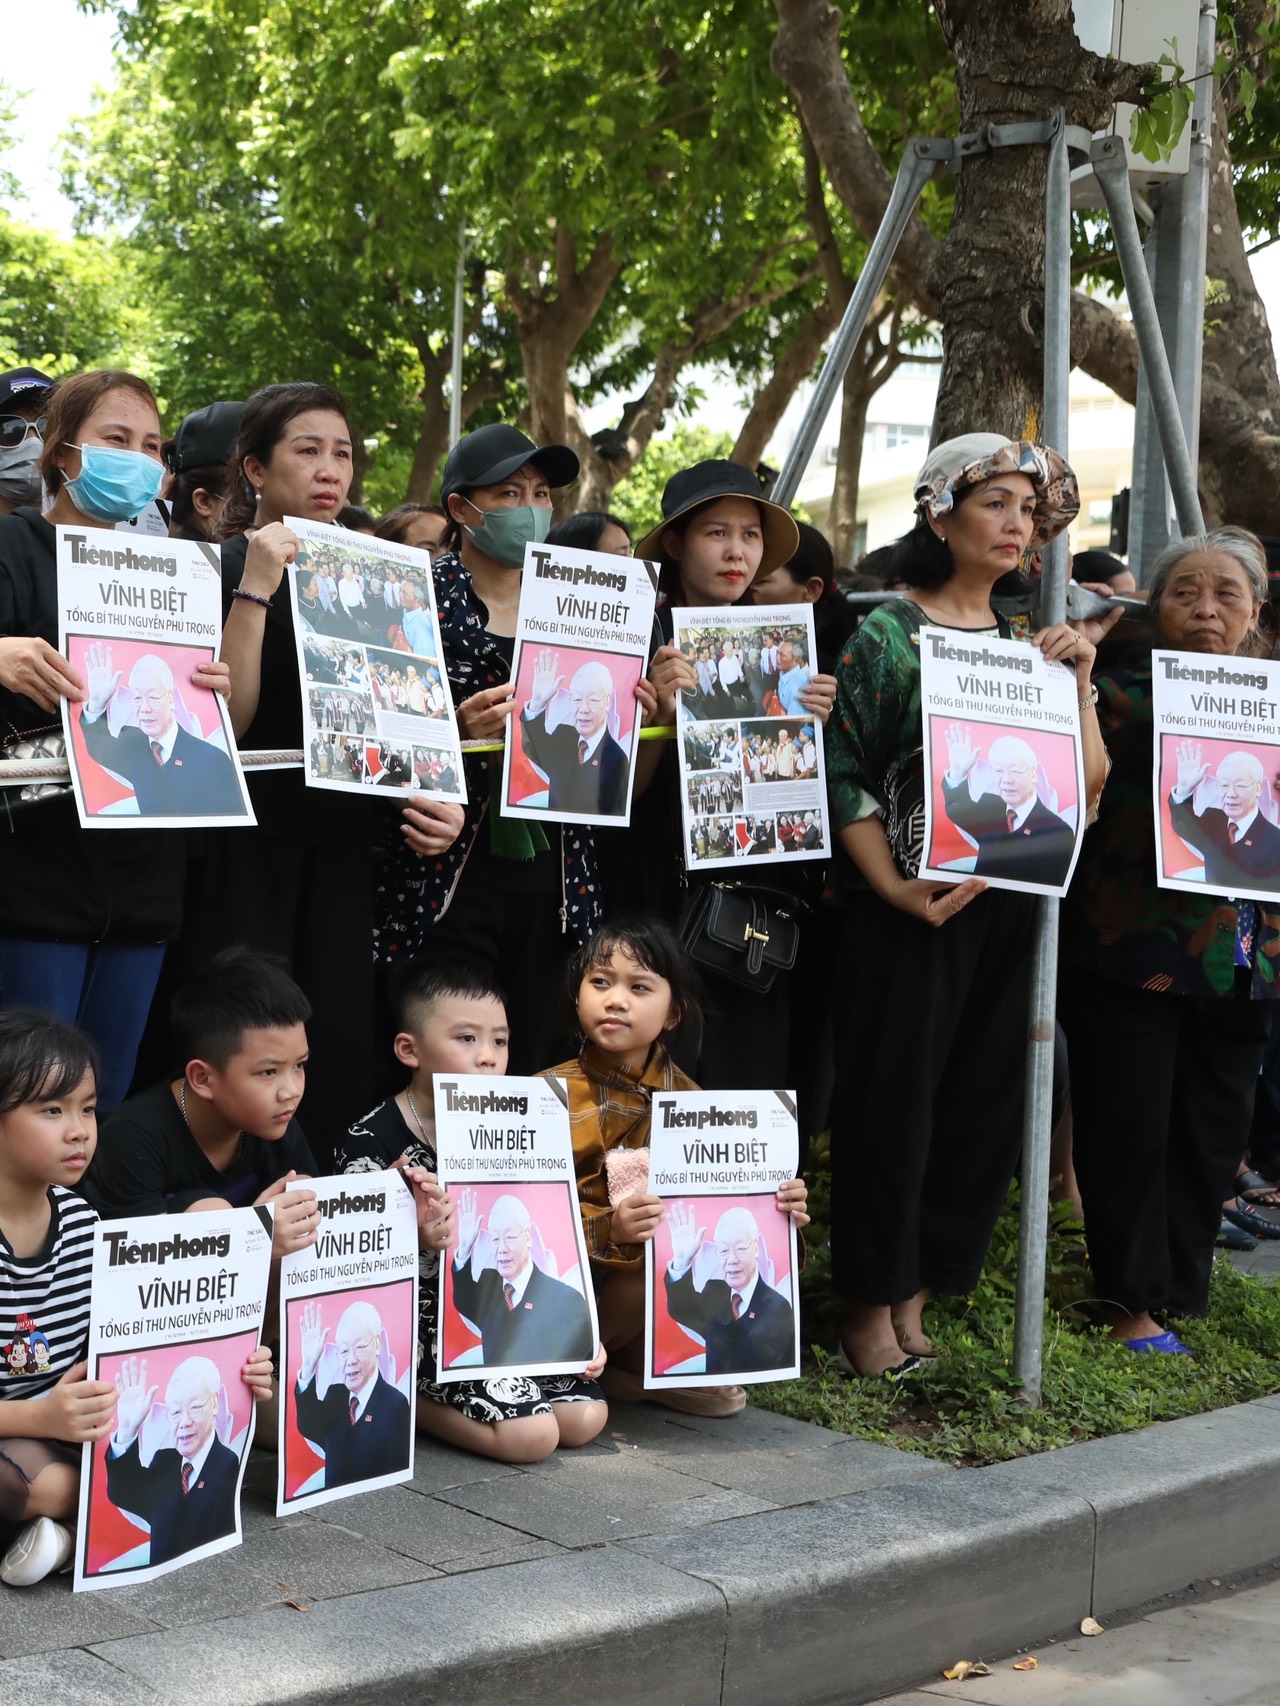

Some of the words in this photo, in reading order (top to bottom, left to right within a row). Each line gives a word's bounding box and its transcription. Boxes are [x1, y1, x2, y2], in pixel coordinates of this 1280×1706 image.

[99, 580, 146, 608] VĨNH
[150, 586, 187, 616] BIỆT
[557, 594, 597, 620] VĨNH
[600, 601, 630, 627] BIỆT
[66, 605, 95, 623] TỔNG
[97, 611, 106, 624] BÍ
[108, 613, 127, 626] THƯ
[128, 614, 165, 630] NGUYỄN
[166, 619, 184, 632] PHÚ
[186, 621, 215, 636] TRỌNG
[525, 616, 548, 632] TỔNG
[550, 621, 559, 633] BÍ
[560, 623, 577, 636] THƯ
[578, 626, 610, 640] NGUYỄN
[611, 630, 624, 642] PHÚ
[626, 632, 646, 646] TRỌNG
[957, 674, 1001, 698] VĨNH
[1006, 682, 1043, 706] BIỆT
[928, 692, 953, 707] TỔNG
[955, 697, 963, 709] BÍ
[965, 700, 983, 711] THƯ
[985, 704, 1022, 717] NGUYỄN
[1024, 709, 1042, 720] PHÚ
[1044, 712, 1073, 725] TRỌNG
[1191, 692, 1236, 715] VĨNH
[1241, 698, 1277, 721] BIỆT
[1161, 712, 1186, 726] TỔNG
[1188, 716, 1197, 726] BÍ
[1199, 718, 1217, 728] THƯ
[1218, 720, 1255, 732] NGUYỄN
[1257, 723, 1275, 734] PHÚ
[469, 1124, 504, 1150] VĨNH
[507, 1125, 536, 1154] BIỆT
[683, 1139, 729, 1164] VĨNH
[734, 1138, 768, 1166] BIỆT
[444, 1154, 466, 1170] TỔNG
[468, 1156, 475, 1169] BÍ
[476, 1158, 489, 1169] THƯ
[490, 1154, 517, 1170] NGUYỄN
[520, 1156, 535, 1169] PHÚ
[538, 1158, 567, 1171] TRỌNG
[655, 1169, 678, 1185] TỔNG
[680, 1170, 688, 1183] BÍ
[690, 1171, 710, 1183] THƯ
[711, 1168, 750, 1182] NGUYỄN
[751, 1168, 767, 1182] PHÚ
[768, 1170, 792, 1181] TRỌNG
[315, 1230, 354, 1259] VĨNH
[359, 1223, 392, 1255] BIỆT
[287, 1267, 309, 1286] TỔNG
[310, 1266, 318, 1282] BÍ
[320, 1264, 337, 1280] THƯ
[337, 1258, 373, 1277] NGUYỄN
[374, 1256, 389, 1272] PHÚ
[391, 1253, 414, 1269] TRỌNG
[138, 1277, 191, 1310] VĨNH
[196, 1269, 238, 1304] BIỆT
[99, 1318, 130, 1339] TỔNG
[132, 1320, 144, 1335] BÍ
[146, 1317, 169, 1333] THƯ
[169, 1307, 211, 1329] NGUYỄN
[213, 1305, 234, 1323] PHÚ
[235, 1301, 262, 1319] TRỌNG
